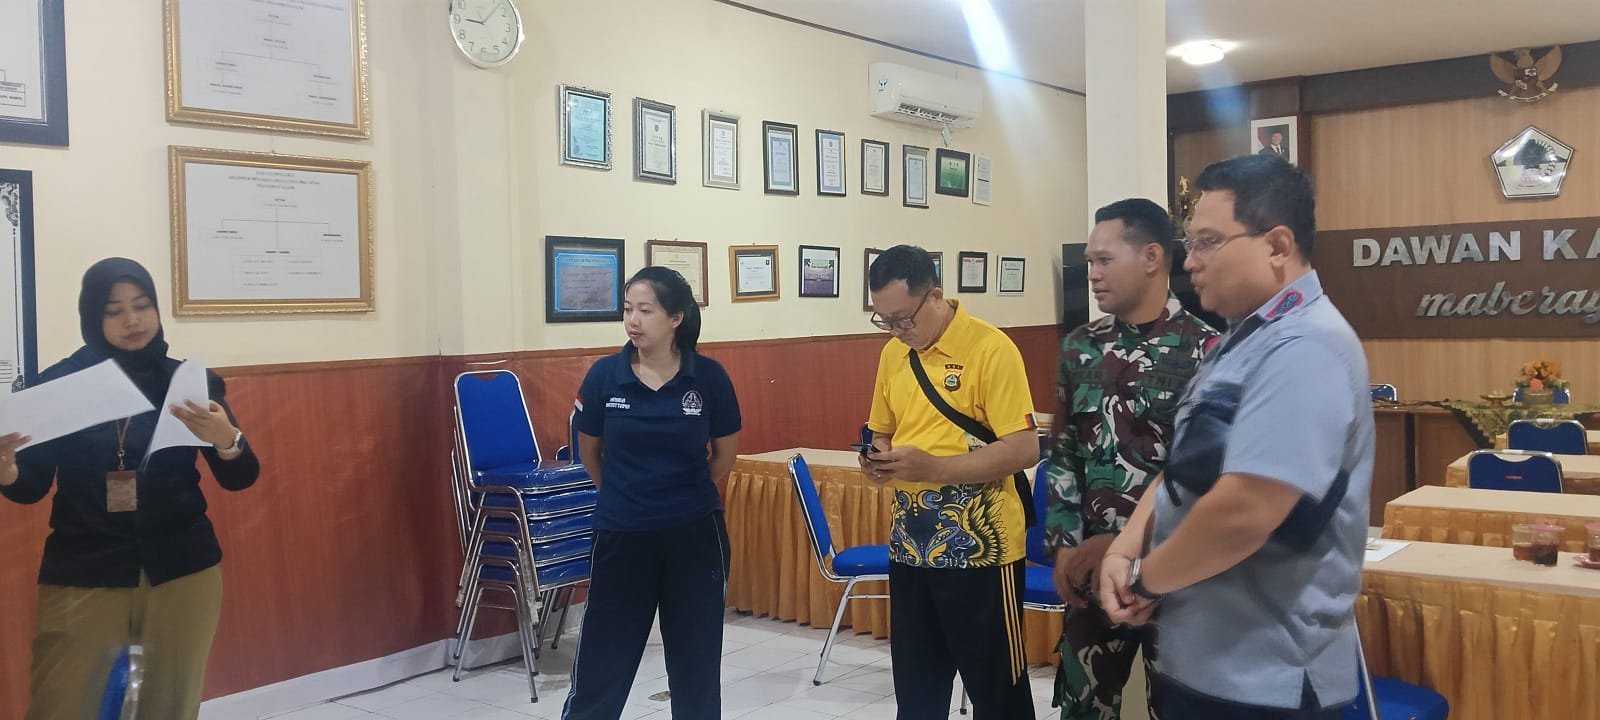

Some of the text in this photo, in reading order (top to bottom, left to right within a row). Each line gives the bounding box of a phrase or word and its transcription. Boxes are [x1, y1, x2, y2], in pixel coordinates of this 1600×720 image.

[501, 7, 507, 17] 2
[454, 13, 461, 24] 9
[504, 23, 511, 32] 3
[459, 29, 466, 40] 8
[501, 36, 508, 45] 4
[468, 41, 475, 52] 7
[492, 45, 500, 55] 5
[1353, 230, 1521, 267] DAWAN
